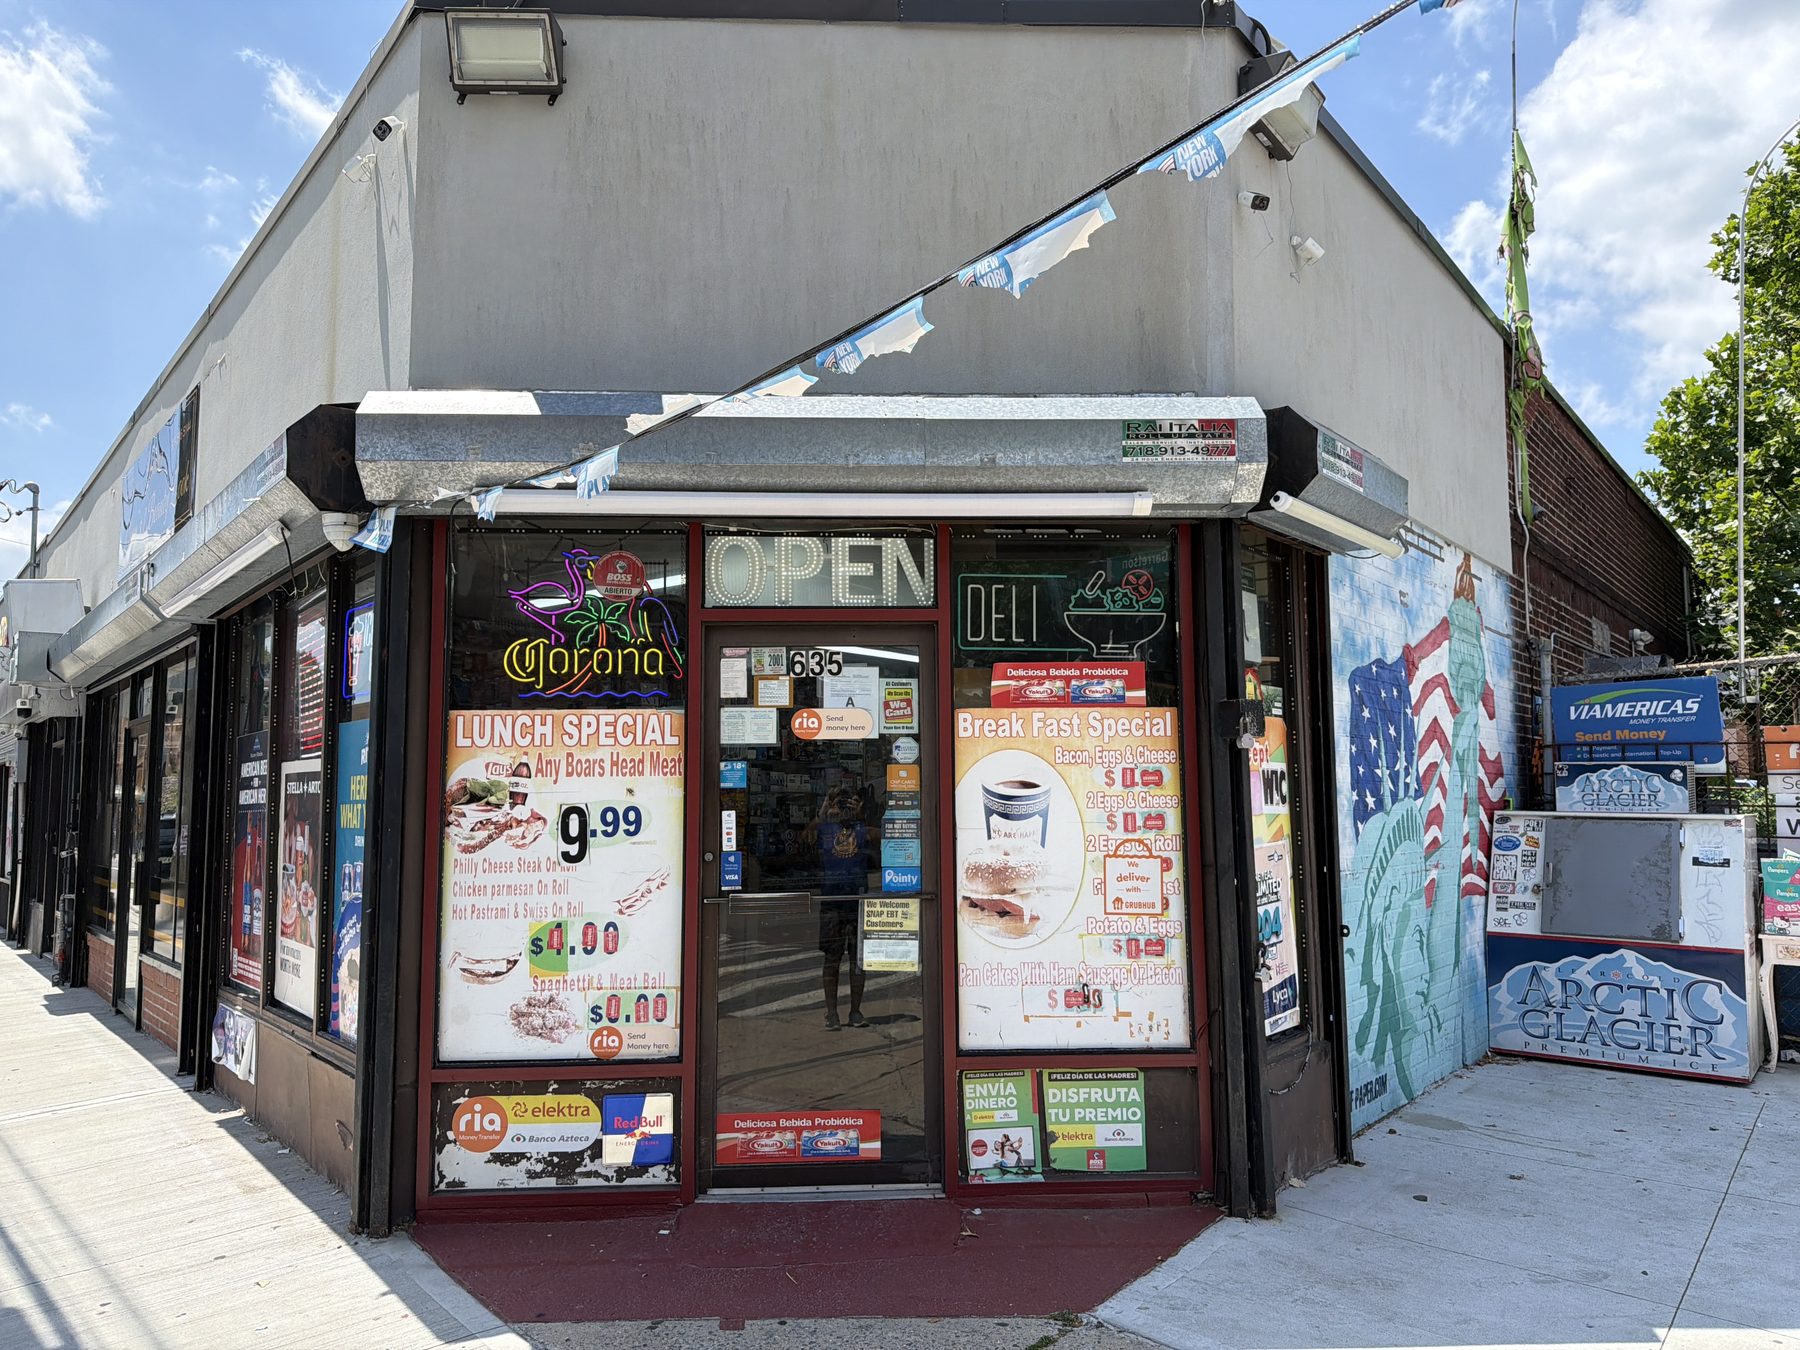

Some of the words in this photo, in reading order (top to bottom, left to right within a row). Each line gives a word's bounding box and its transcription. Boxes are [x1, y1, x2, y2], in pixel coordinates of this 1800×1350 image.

[1177, 134, 1207, 160] NEW
[1181, 145, 1219, 182] YORK
[976, 255, 999, 276] NEW
[979, 267, 1008, 289] YORK
[835, 342, 853, 359] NEW
[1169, 421, 1231, 432] ITALIA
[1126, 446, 1231, 456] 718-913-4977
[607, 573, 632, 582] BOSS
[705, 536, 934, 606] OPEN
[968, 585, 1036, 642] DELI
[504, 638, 664, 689] Corona
[768, 653, 784, 667] 2001
[790, 651, 842, 677] 635
[1007, 668, 1047, 677] Deliciosa
[1050, 668, 1080, 677] Bebida
[1083, 667, 1129, 677] Probiótica
[886, 707, 912, 717] Card
[889, 700, 907, 709] We
[1569, 697, 1701, 721] VIAMERICAS
[795, 713, 819, 728] ria
[957, 711, 1026, 738] Break
[1031, 711, 1081, 737] Fast
[1087, 711, 1172, 743] Special
[1657, 715, 1697, 724] TRANSFER
[456, 714, 553, 748] LUNCH
[562, 713, 680, 747] SPECIAL
[1575, 730, 1611, 742] Send
[1616, 729, 1666, 742] Money
[1054, 746, 1092, 767] Bacon,
[1094, 746, 1121, 768] Eggs
[1124, 746, 1135, 764] &
[1135, 746, 1177, 764] Cheese
[535, 752, 560, 784] Any
[565, 752, 605, 778] Boars
[609, 751, 645, 777] Head
[650, 752, 682, 777] Meat
[287, 781, 303, 794] STELLA
[1581, 775, 1661, 794] ARCTIC
[1086, 792, 1095, 808] 2
[1096, 791, 1124, 812] Eggs
[1127, 792, 1138, 808] &
[1138, 791, 1180, 809] Cheese
[1581, 793, 1661, 807] GLACIER
[341, 804, 361, 829] WHAT
[1086, 835, 1096, 852] 2
[1154, 833, 1181, 852] Roll
[453, 858, 479, 881] Philly
[482, 857, 514, 874] Cheese
[517, 857, 542, 873] Steak
[546, 857, 557, 873] On
[885, 870, 918, 885] Pointy
[1767, 866, 1789, 874] Pampers
[1116, 873, 1151, 883] deliver
[452, 881, 487, 897] Chicken
[491, 883, 533, 900] parmesan
[537, 880, 549, 896] On
[552, 879, 569, 895] Roll
[1776, 889, 1798, 897] Pampers
[452, 904, 467, 920] Hot
[470, 903, 510, 920] Pastrami
[513, 904, 519, 918] &
[523, 903, 548, 918] Swiss
[552, 902, 563, 918] On
[566, 901, 584, 918] Roll
[879, 901, 909, 909] Welcome
[1125, 902, 1156, 910] GRUBHUB
[866, 910, 884, 918] SNAP
[887, 910, 898, 918] EBT
[866, 920, 903, 928] Customers
[1086, 917, 1129, 934] Potato
[1134, 917, 1145, 934] &
[1149, 917, 1182, 938] Eggs
[959, 963, 981, 986] Pan
[982, 962, 1019, 986] Cakes
[1020, 962, 1049, 985] With
[1050, 962, 1076, 985] Ham
[1079, 962, 1128, 990] Sausage
[1130, 962, 1146, 985] Or
[1147, 962, 1183, 985] Bacon
[1543, 965, 1606, 979] CLEAR
[1626, 972, 1681, 983] COLD
[532, 974, 591, 996] Spaghetti
[597, 974, 603, 990] &
[609, 974, 638, 990] Meat
[643, 972, 665, 989] Ball
[1272, 988, 1287, 1004] Lyca
[1517, 965, 1724, 1025] ARCTIC
[593, 1030, 619, 1048] ria
[1518, 1008, 1726, 1061] GLACIER
[627, 1042, 651, 1050] Money
[653, 1041, 669, 1049] here
[1524, 1040, 1650, 1065] PREMIUM
[1672, 1059, 1719, 1073] ICE
[966, 1079, 1017, 1098] ENVÍA
[1048, 1087, 1141, 1103] DISFRUTA
[531, 1101, 590, 1118] elektra
[966, 1097, 1017, 1109] DINERO
[459, 1103, 501, 1132] ria
[614, 1116, 638, 1129] Red
[640, 1115, 663, 1128] Bull
[734, 1119, 777, 1129] Deliciosa
[780, 1118, 812, 1127] Bebida
[815, 1117, 863, 1127] Probiótica
[1048, 1108, 1070, 1122] TU
[1074, 1107, 1141, 1121] PREMIO
[458, 1134, 478, 1142] Money
[479, 1133, 500, 1141] Transfer
[558, 1134, 589, 1143] Azteca
[756, 1141, 778, 1149] Yakult
[1061, 1132, 1093, 1141] elektra
